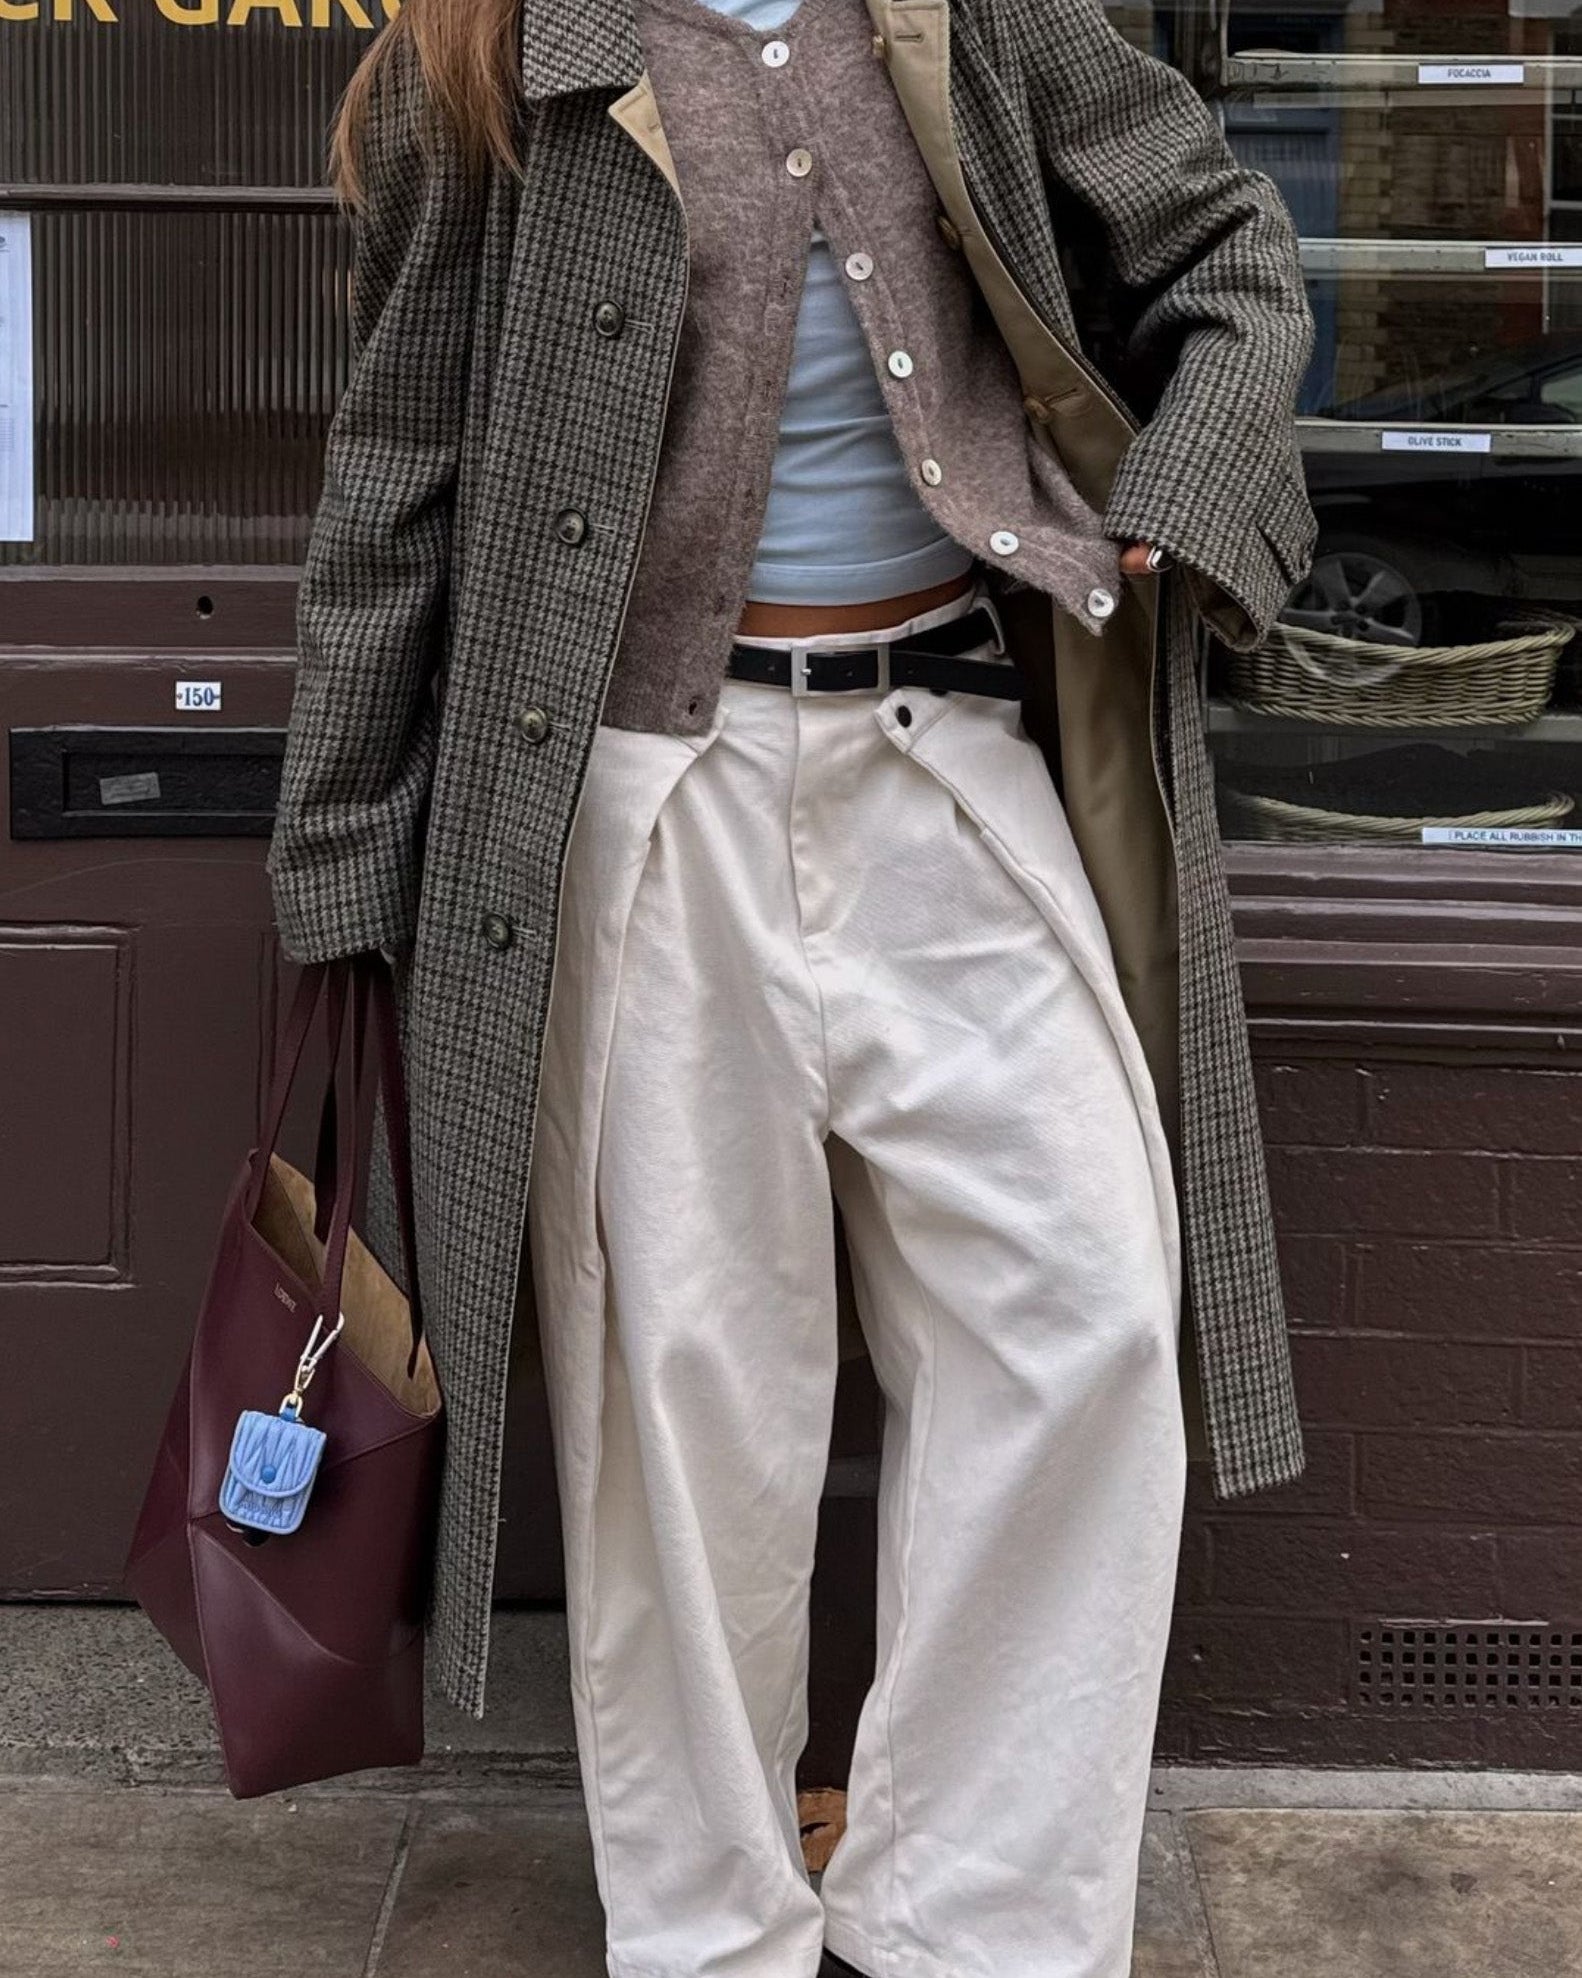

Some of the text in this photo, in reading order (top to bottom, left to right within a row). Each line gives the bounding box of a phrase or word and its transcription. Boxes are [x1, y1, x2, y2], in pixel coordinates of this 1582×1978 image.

[1447, 68, 1492, 79] FOCACCIA
[1507, 252, 1564, 262] VEGAN ROLL
[1407, 435, 1462, 448] OLIVE STICK
[184, 686, 215, 708] 150
[1454, 831, 1488, 841] PLACE
[1489, 832, 1507, 841] ALL
[1509, 832, 1554, 842] RUBBISH
[1556, 832, 1567, 842] IN
